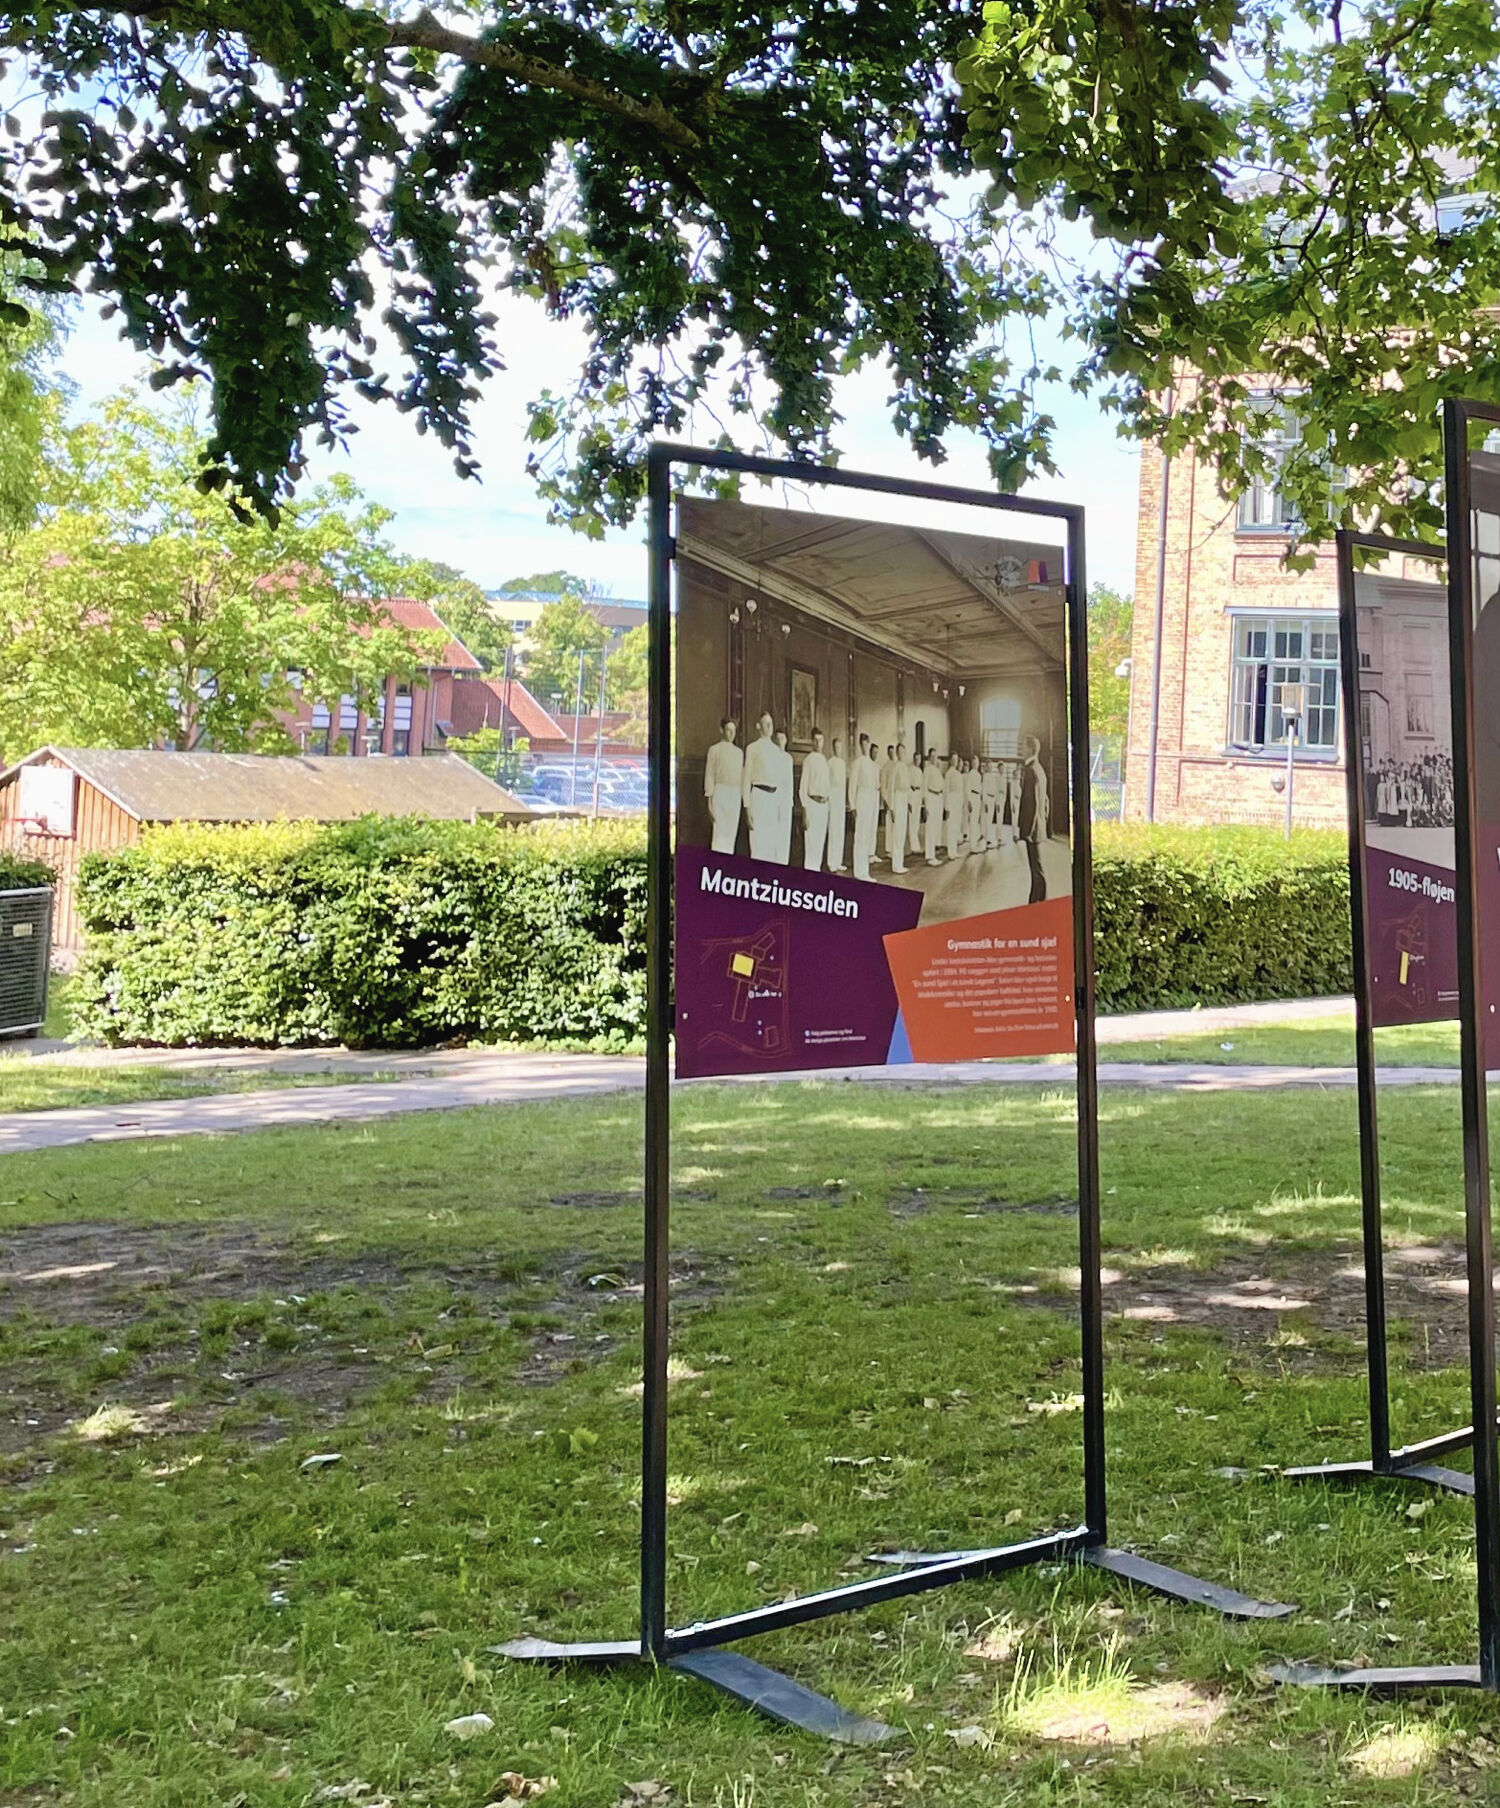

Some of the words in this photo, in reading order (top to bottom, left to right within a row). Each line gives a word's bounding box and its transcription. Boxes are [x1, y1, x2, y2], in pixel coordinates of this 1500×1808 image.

[700, 866, 859, 919] Mantziussalen
[1388, 867, 1455, 904] 1905-fløjen
[947, 938, 993, 952] Gymnastik
[994, 937, 1006, 949] for
[1007, 940, 1019, 949] en
[1019, 937, 1040, 949] sund
